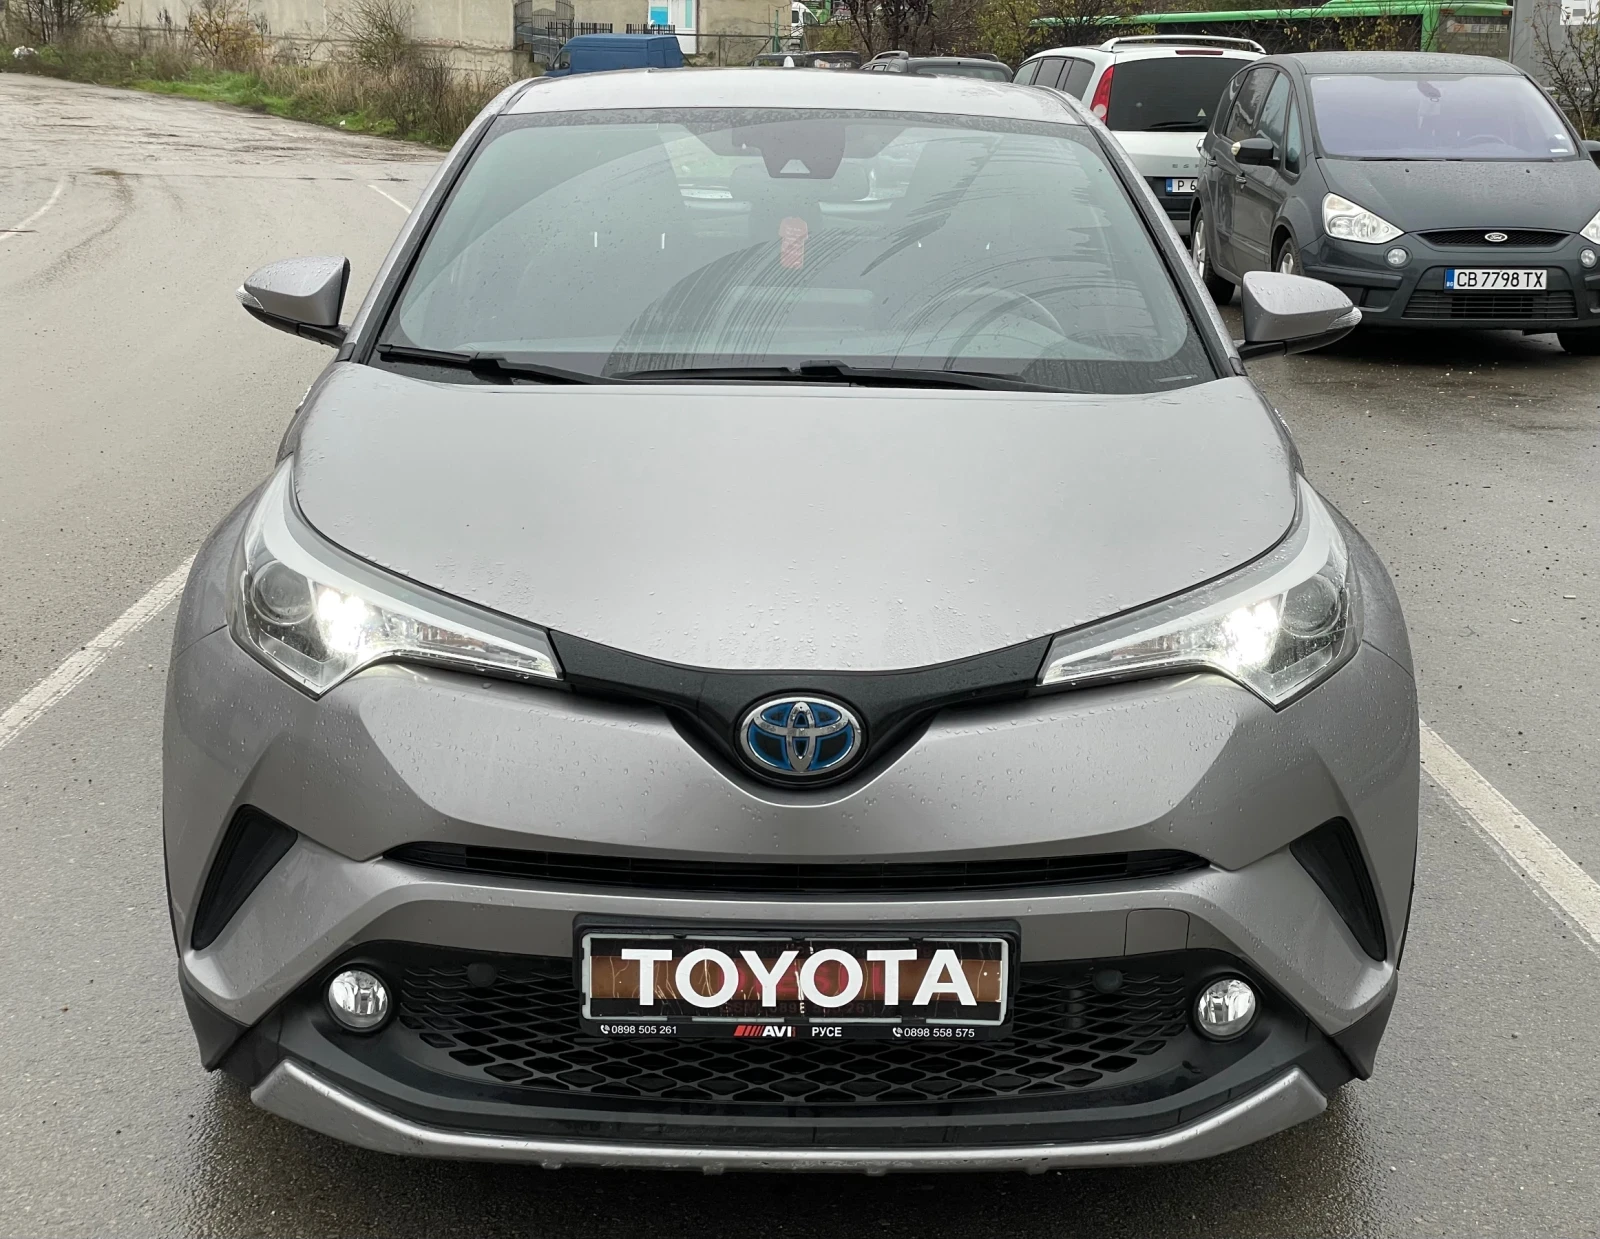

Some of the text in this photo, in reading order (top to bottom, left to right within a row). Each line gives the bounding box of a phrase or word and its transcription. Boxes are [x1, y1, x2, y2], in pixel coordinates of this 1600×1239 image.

[1457, 271, 1544, 288] CB 7798 TX
[621, 948, 977, 1008] TOYOTA
[611, 1025, 677, 1034] 0898 505 261
[903, 1027, 975, 1038] 0898 558 575
